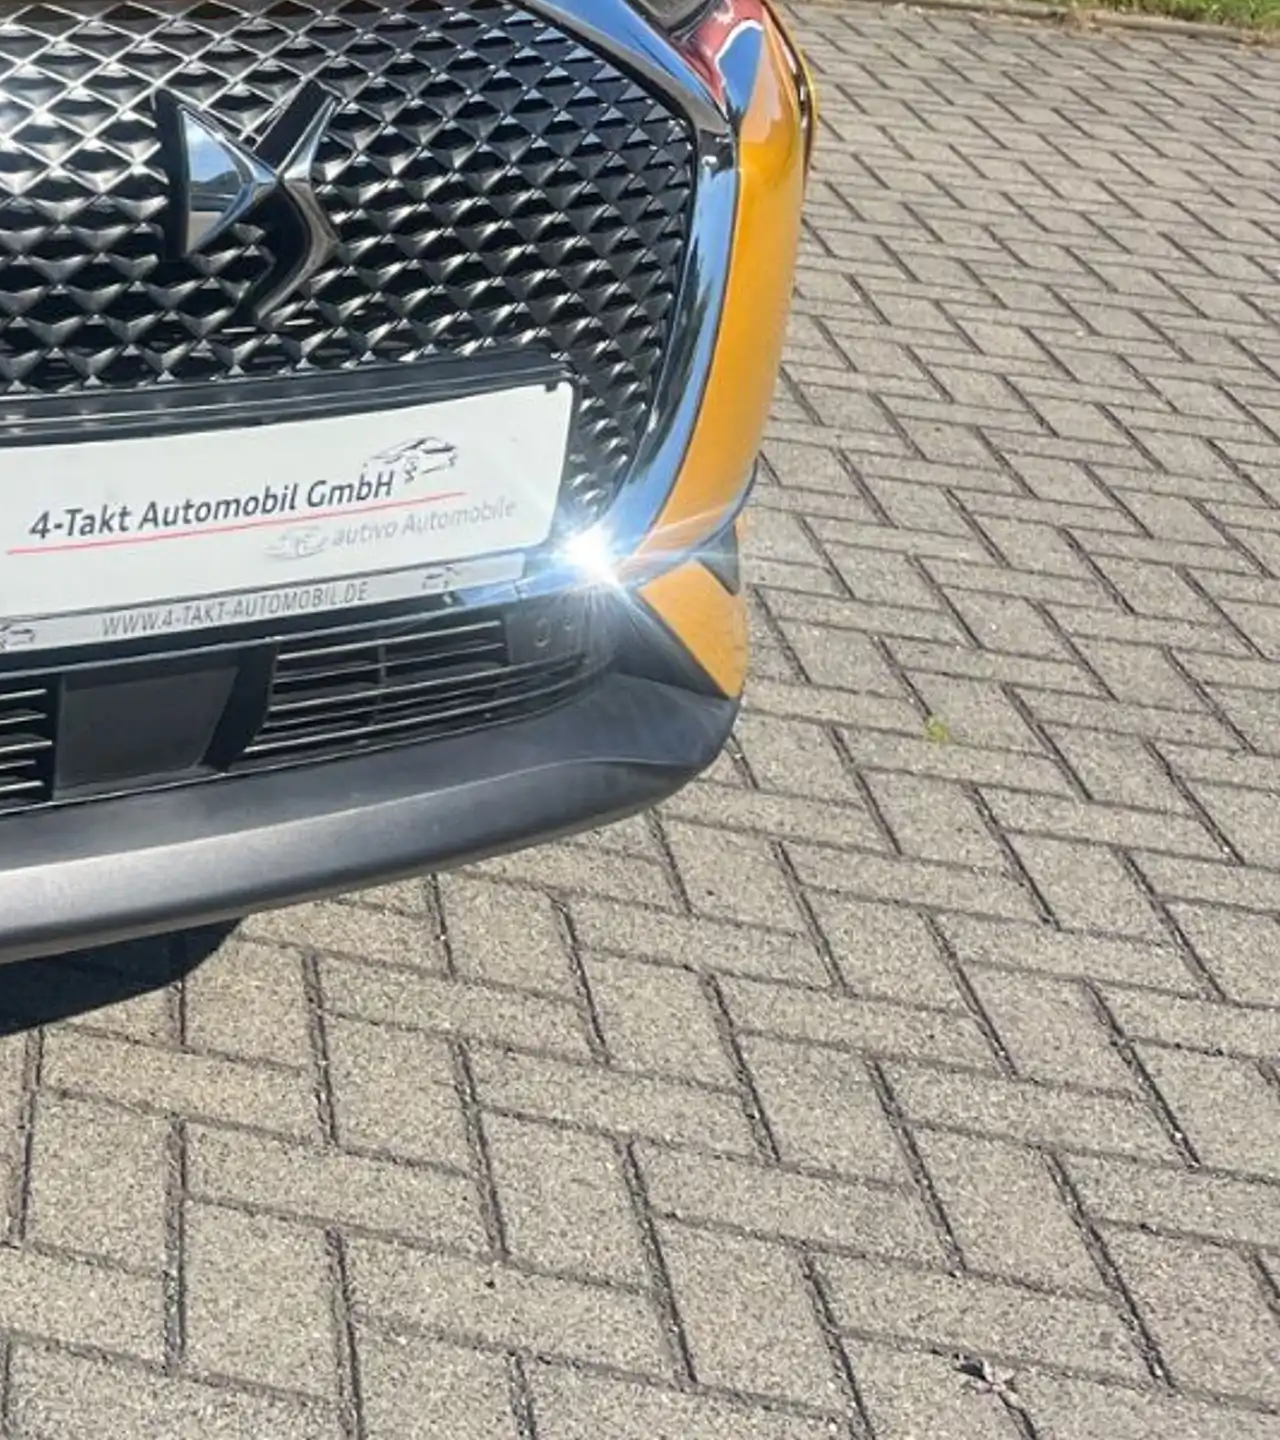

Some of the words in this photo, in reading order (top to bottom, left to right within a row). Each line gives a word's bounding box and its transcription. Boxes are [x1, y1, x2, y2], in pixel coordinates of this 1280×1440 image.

[29, 508, 131, 540] 4-Takt
[138, 482, 297, 531] Automobil
[306, 469, 395, 507] GmbH
[333, 520, 398, 547] autivo
[402, 495, 517, 536] Automobile
[100, 580, 370, 637] WWW.4-TAKT-AUTOMOBIL.DE
